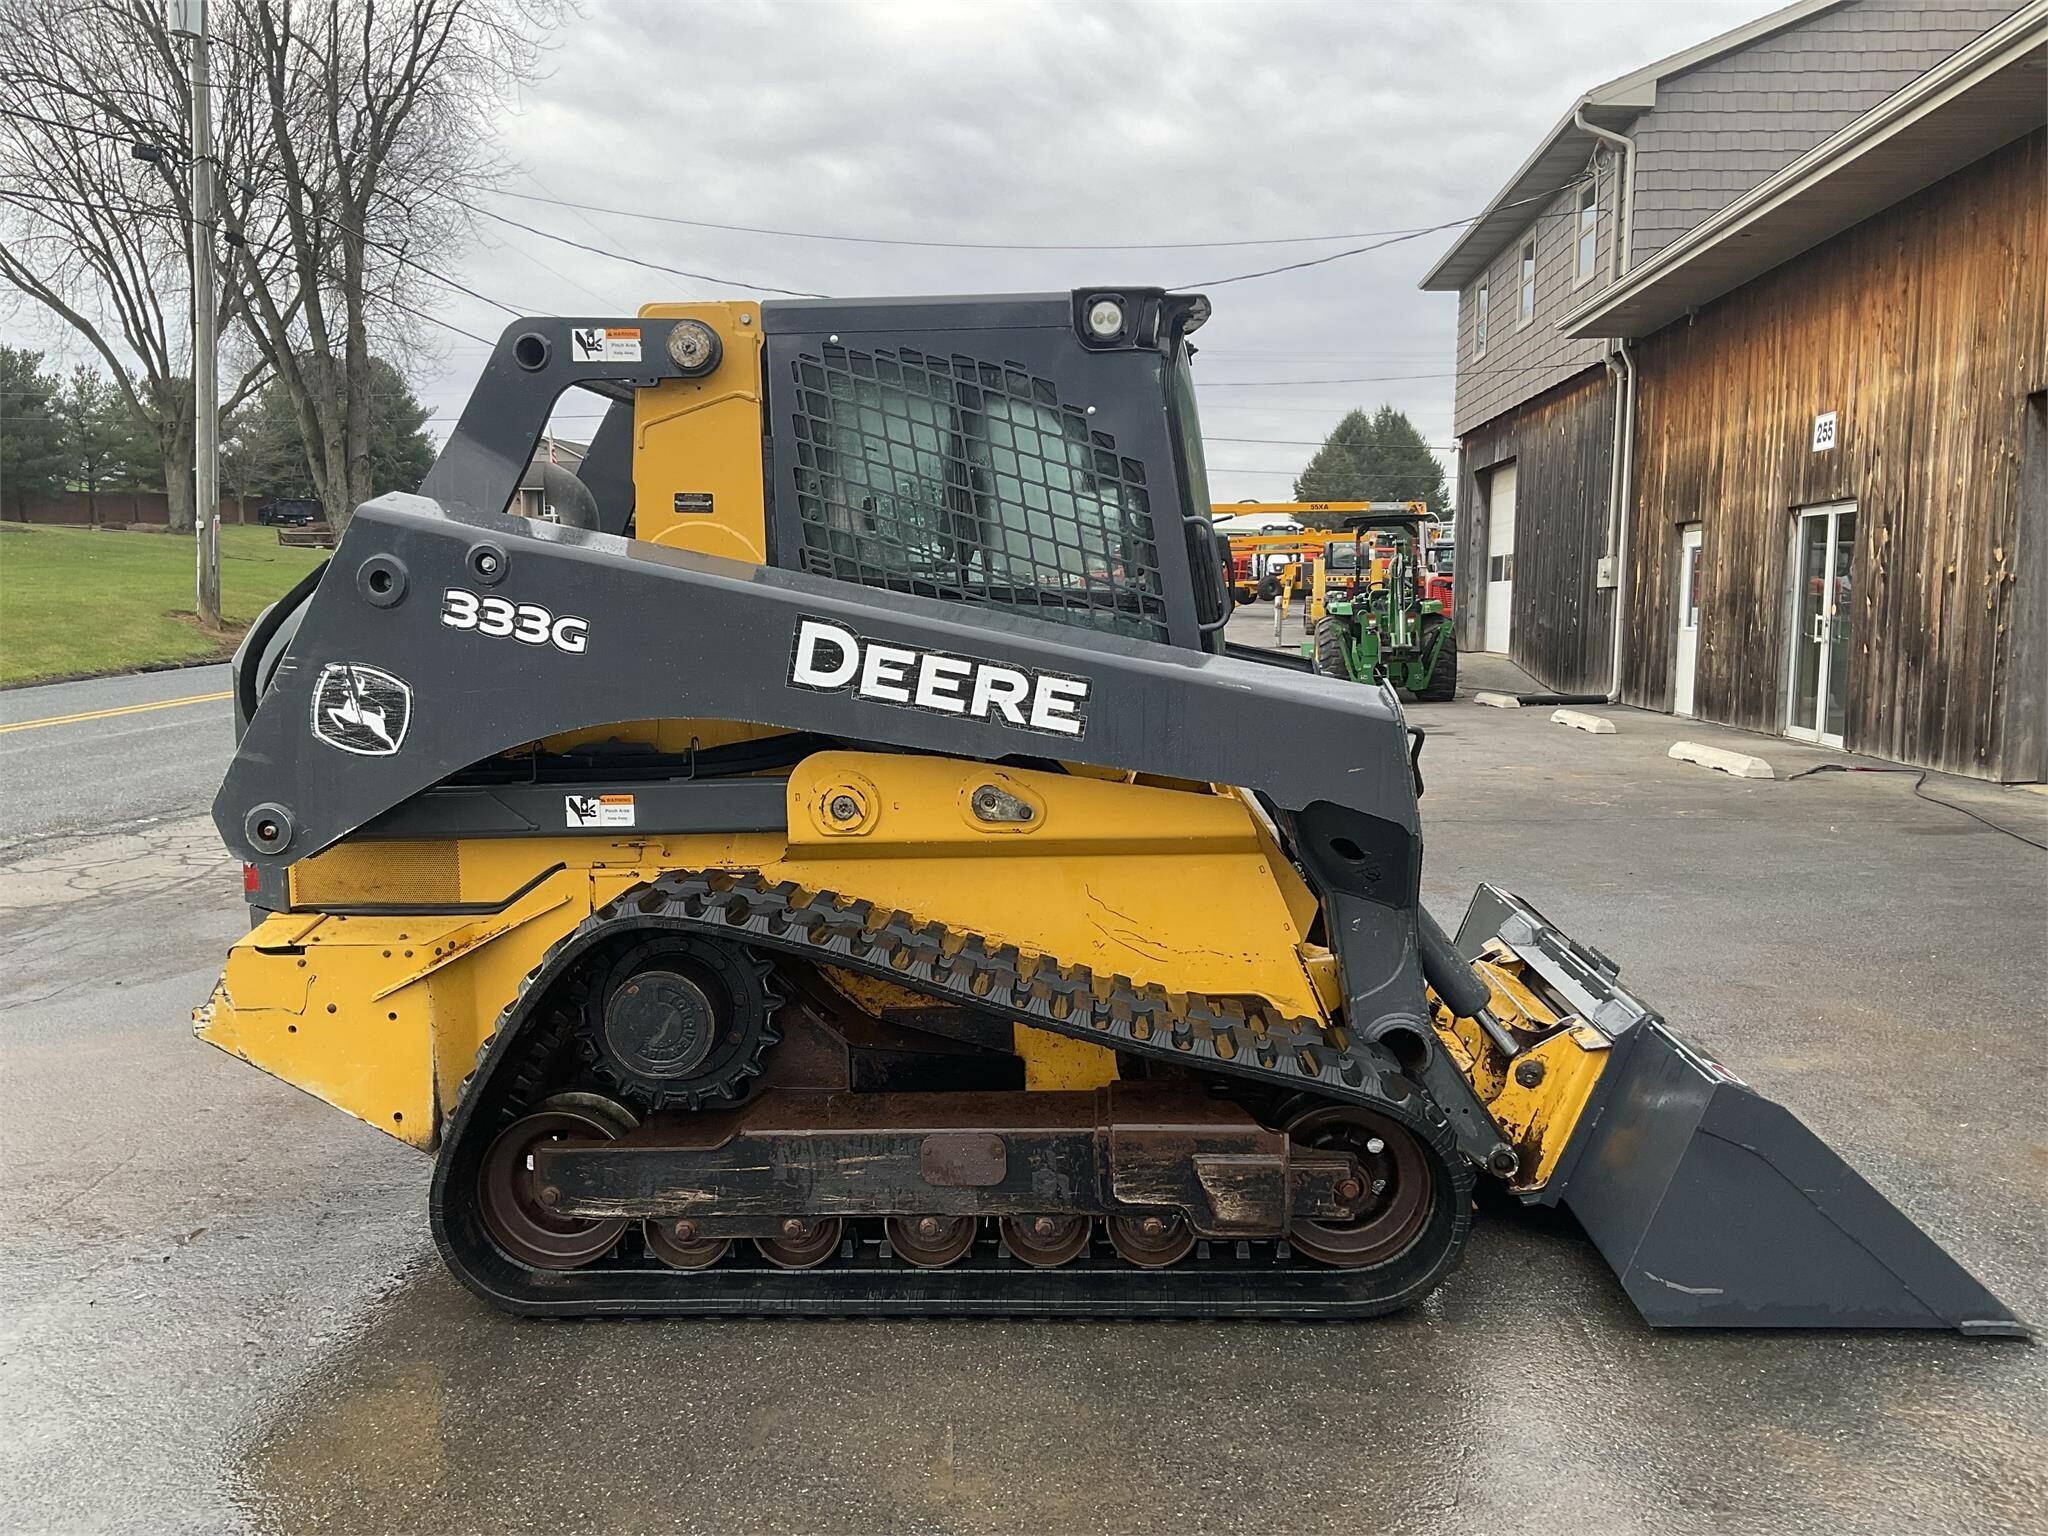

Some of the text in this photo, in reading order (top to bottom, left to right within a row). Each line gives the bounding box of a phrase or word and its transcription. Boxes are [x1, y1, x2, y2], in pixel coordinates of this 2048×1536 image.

[1816, 420, 1833, 443] 255
[442, 588, 590, 655] 333G
[792, 619, 1089, 735] DEERE
